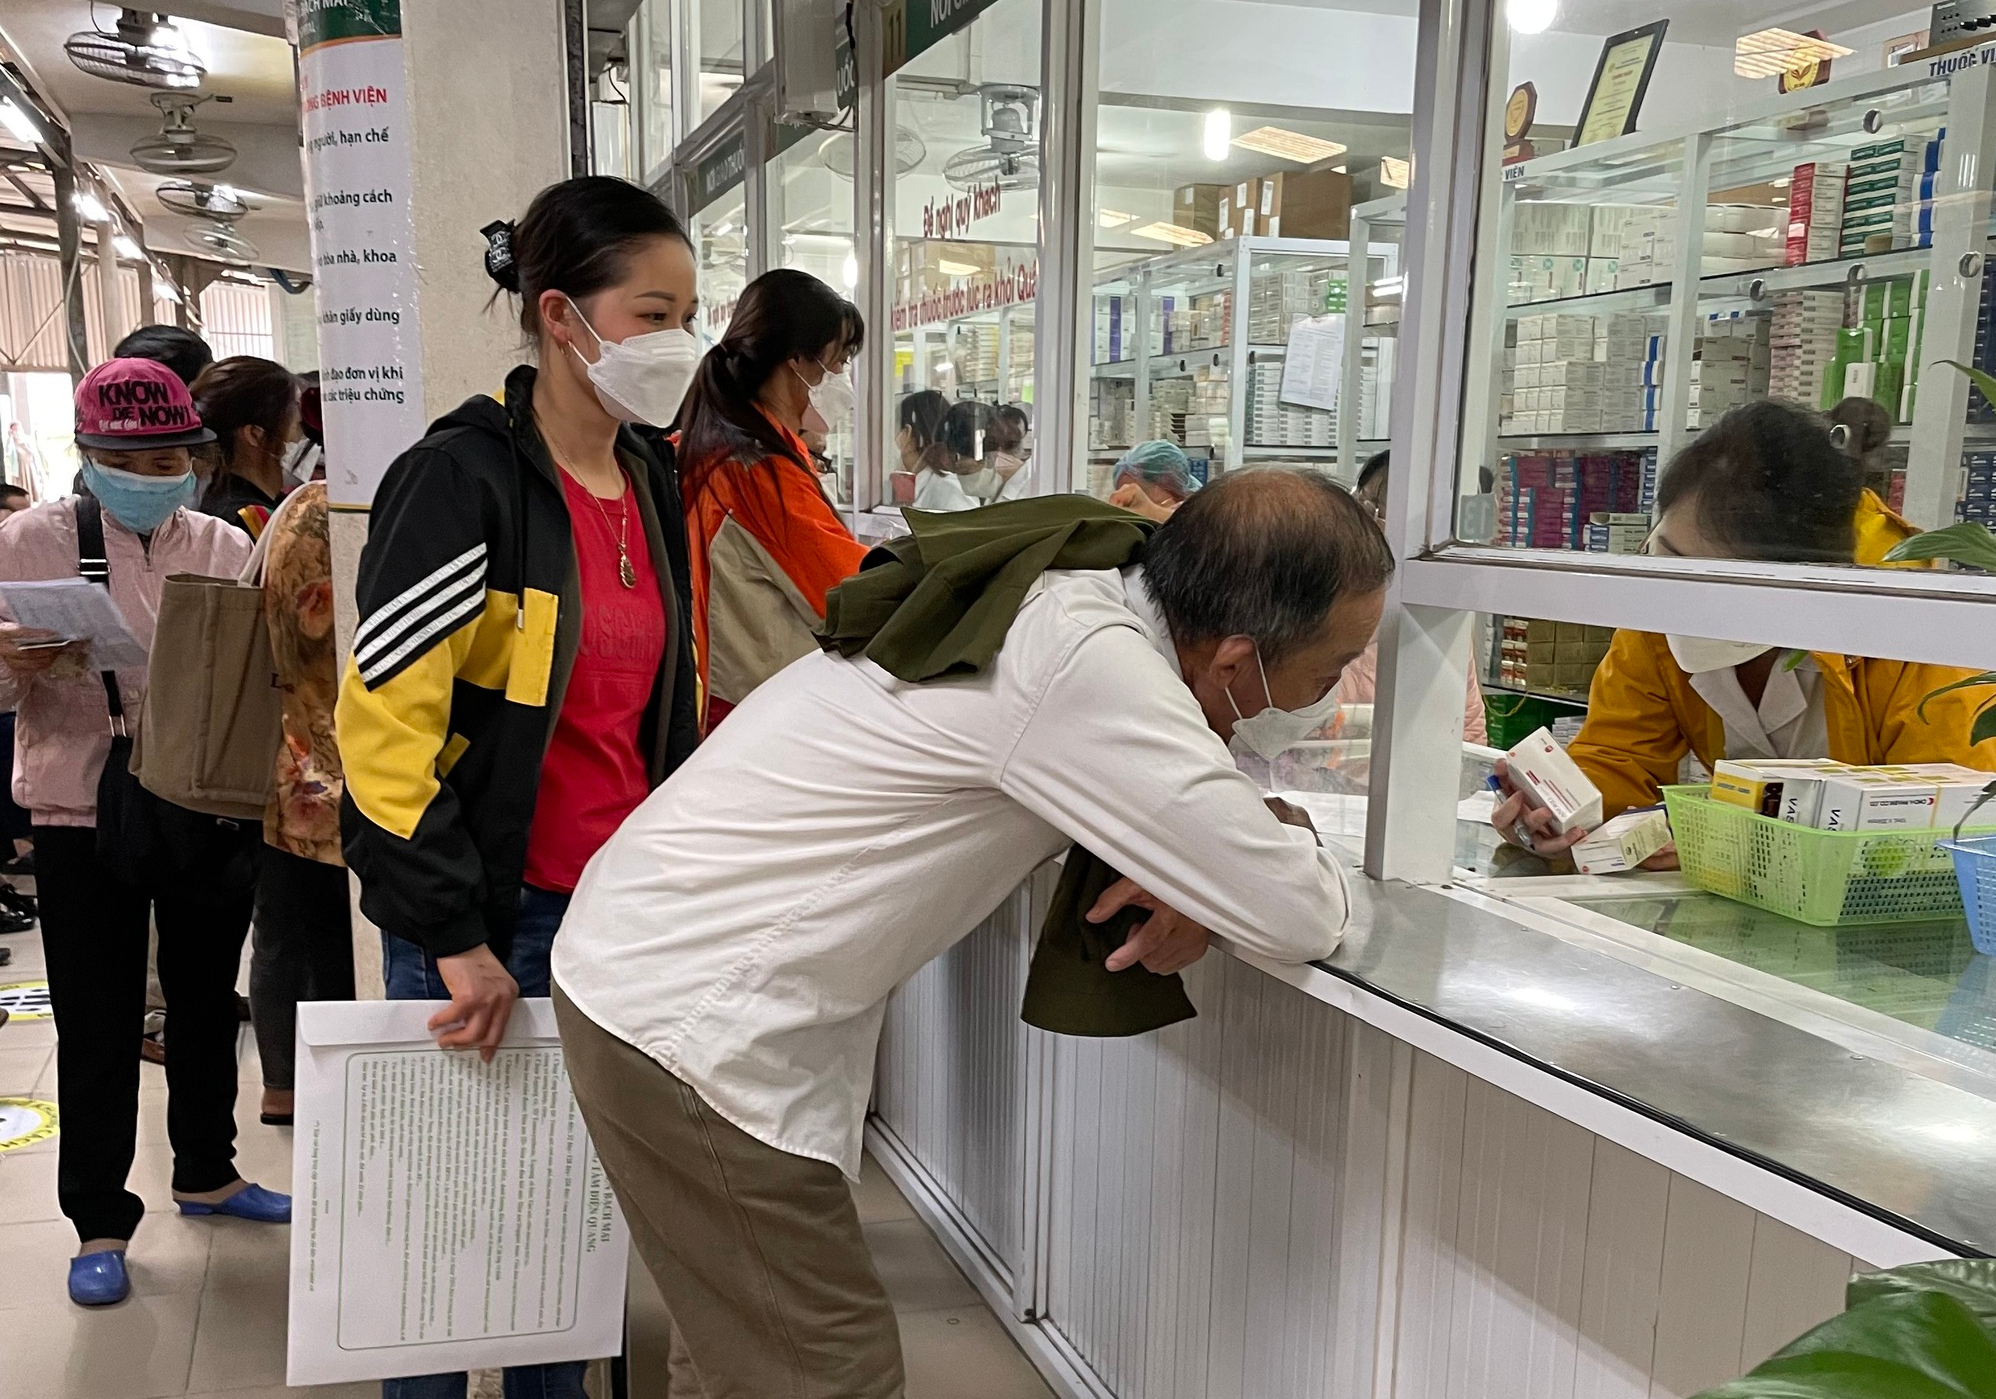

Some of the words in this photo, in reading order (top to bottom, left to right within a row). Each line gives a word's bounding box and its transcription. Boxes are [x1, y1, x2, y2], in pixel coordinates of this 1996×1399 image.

[889, 8, 901, 64] 11
[321, 89, 350, 111] BỆNH
[353, 85, 387, 107] VIỆN
[340, 130, 362, 147] hạn
[365, 126, 389, 142] chế
[323, 189, 360, 207] khoảng
[363, 188, 393, 203] cách
[956, 185, 971, 236] quý
[337, 250, 360, 265] nhà,
[364, 249, 397, 263] khoa
[967, 277, 980, 313] lúc
[983, 284, 992, 309] ra
[994, 256, 1015, 306] khỏi
[340, 307, 362, 325] giấy
[366, 308, 400, 325] dùng
[345, 366, 366, 380] đơn
[368, 366, 380, 383] vị
[382, 366, 404, 380] khi
[98, 380, 170, 407] KNOW
[338, 388, 361, 404] triệu
[365, 387, 404, 404] chứng
[586, 1216, 598, 1252] QUANG
